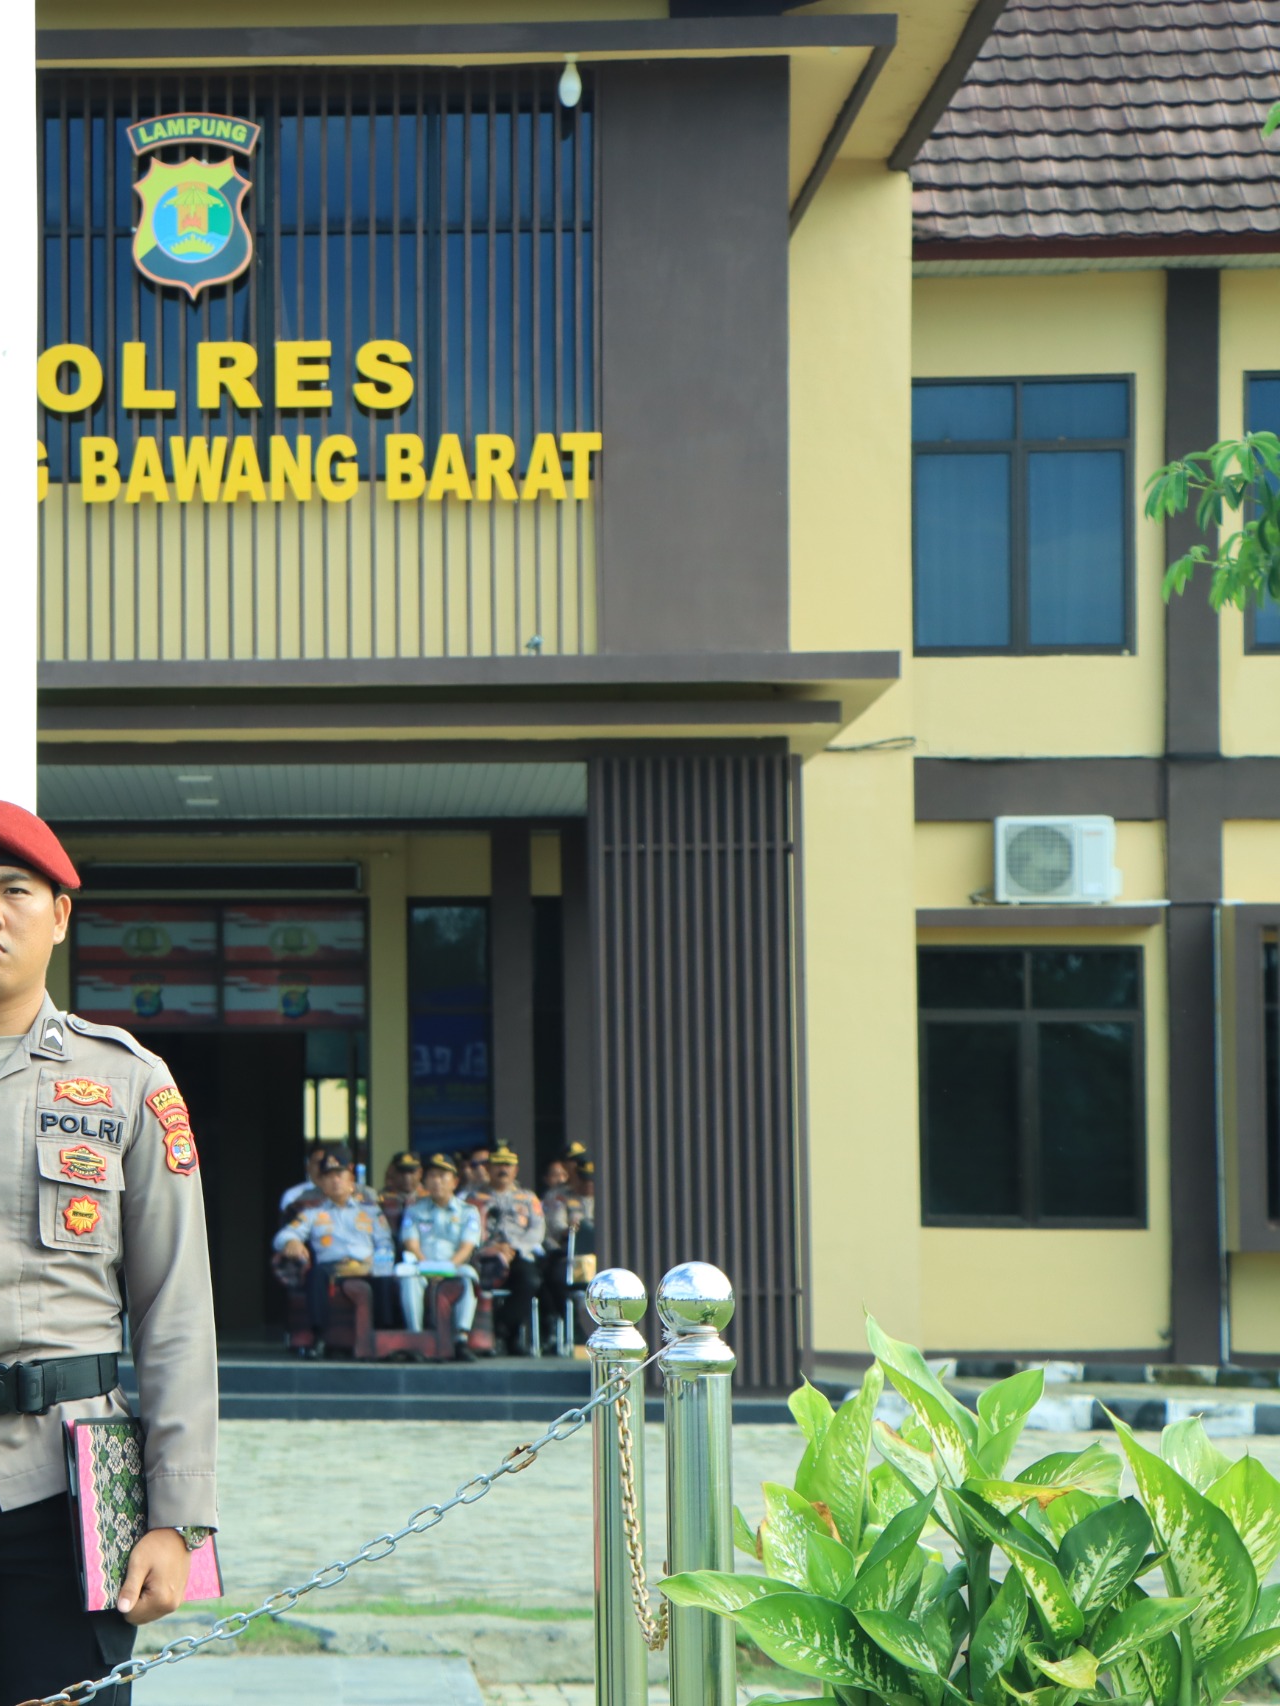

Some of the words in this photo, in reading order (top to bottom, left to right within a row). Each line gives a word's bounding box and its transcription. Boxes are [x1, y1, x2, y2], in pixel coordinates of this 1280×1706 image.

[138, 117, 248, 144] LAMPUNG
[37, 340, 415, 412] OLRES
[81, 435, 359, 503] BAWANG
[386, 432, 602, 501] BARAT
[40, 1112, 123, 1144] POLRI
